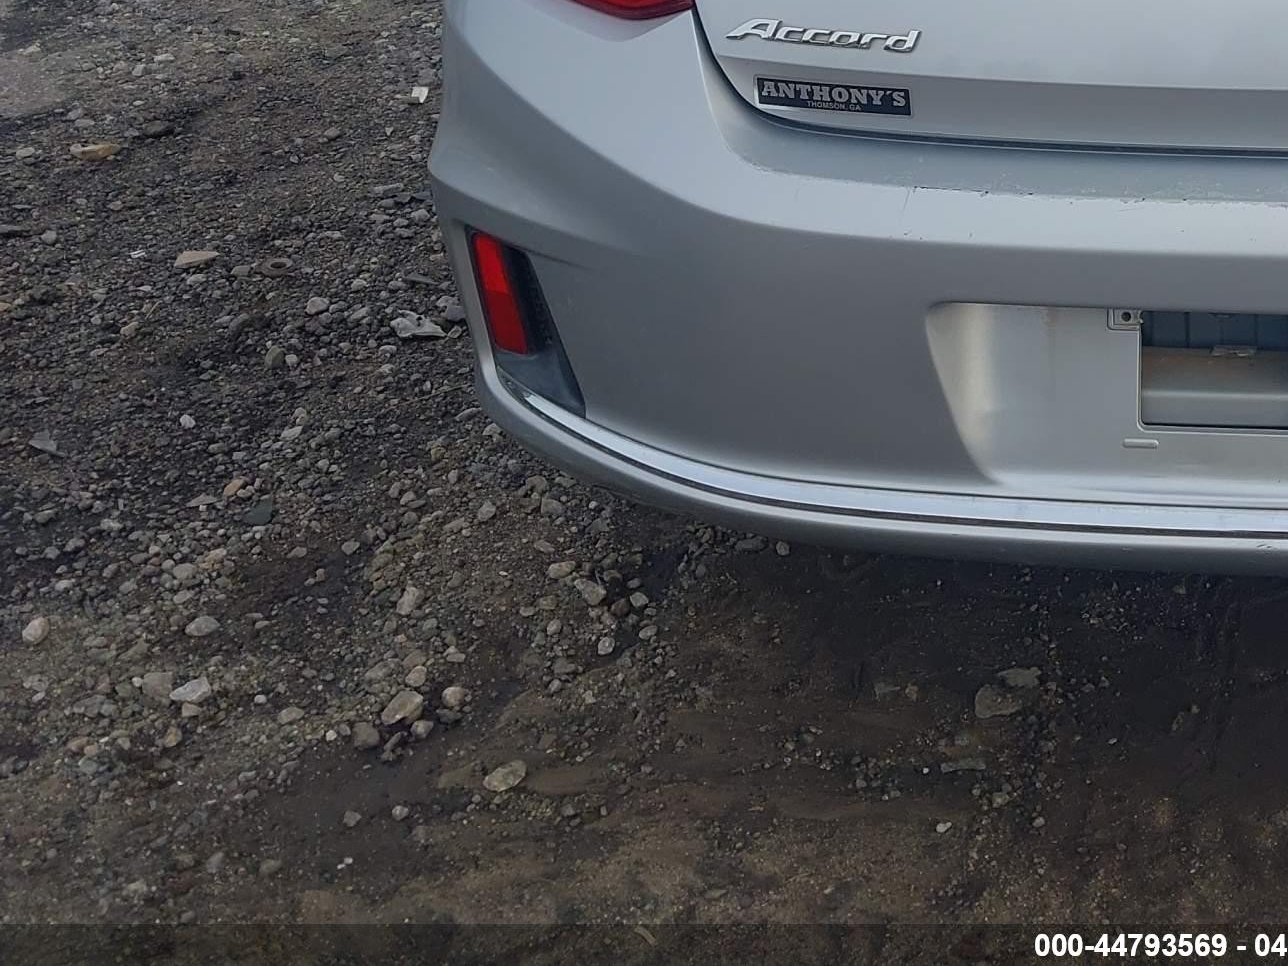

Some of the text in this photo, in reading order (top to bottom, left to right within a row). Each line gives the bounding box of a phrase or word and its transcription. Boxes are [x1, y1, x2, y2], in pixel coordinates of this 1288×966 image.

[725, 18, 921, 52] Accord
[761, 80, 906, 108] ANTHONY'S
[849, 103, 862, 112] GA
